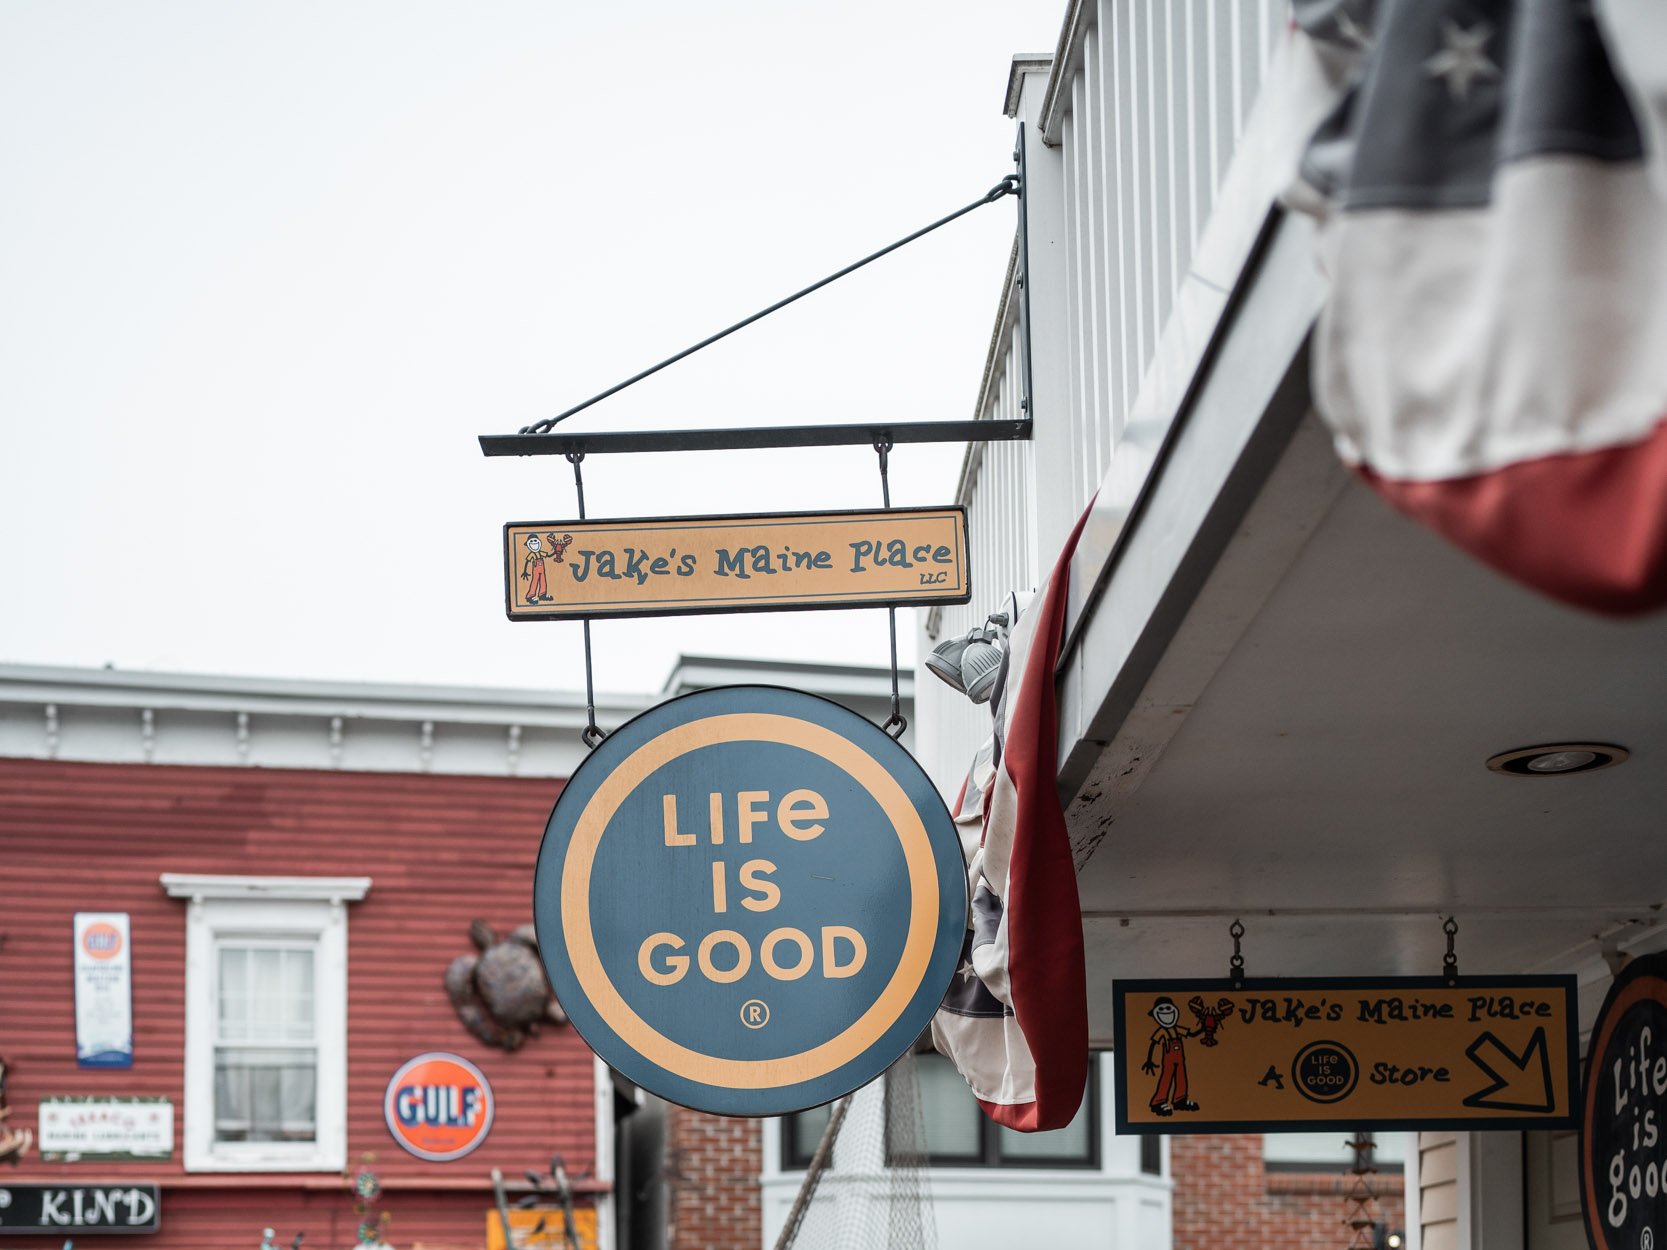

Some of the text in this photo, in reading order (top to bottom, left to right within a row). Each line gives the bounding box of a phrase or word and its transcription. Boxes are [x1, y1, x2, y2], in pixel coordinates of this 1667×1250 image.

[569, 538, 954, 585] Jake's Maine Place
[919, 571, 948, 585] LLC
[712, 859, 782, 913] IS
[637, 926, 868, 986] GOOD
[1238, 996, 1553, 1027] Jake's Maine Place
[1257, 1061, 1451, 1089] A Store
[1306, 1075, 1345, 1085] GOOD
[1319, 1065, 1331, 1075] IS
[396, 1085, 483, 1127] GULF
[1633, 1106, 1659, 1151] is
[39, 1188, 155, 1226] KIND
[1608, 1149, 1667, 1227] goo
